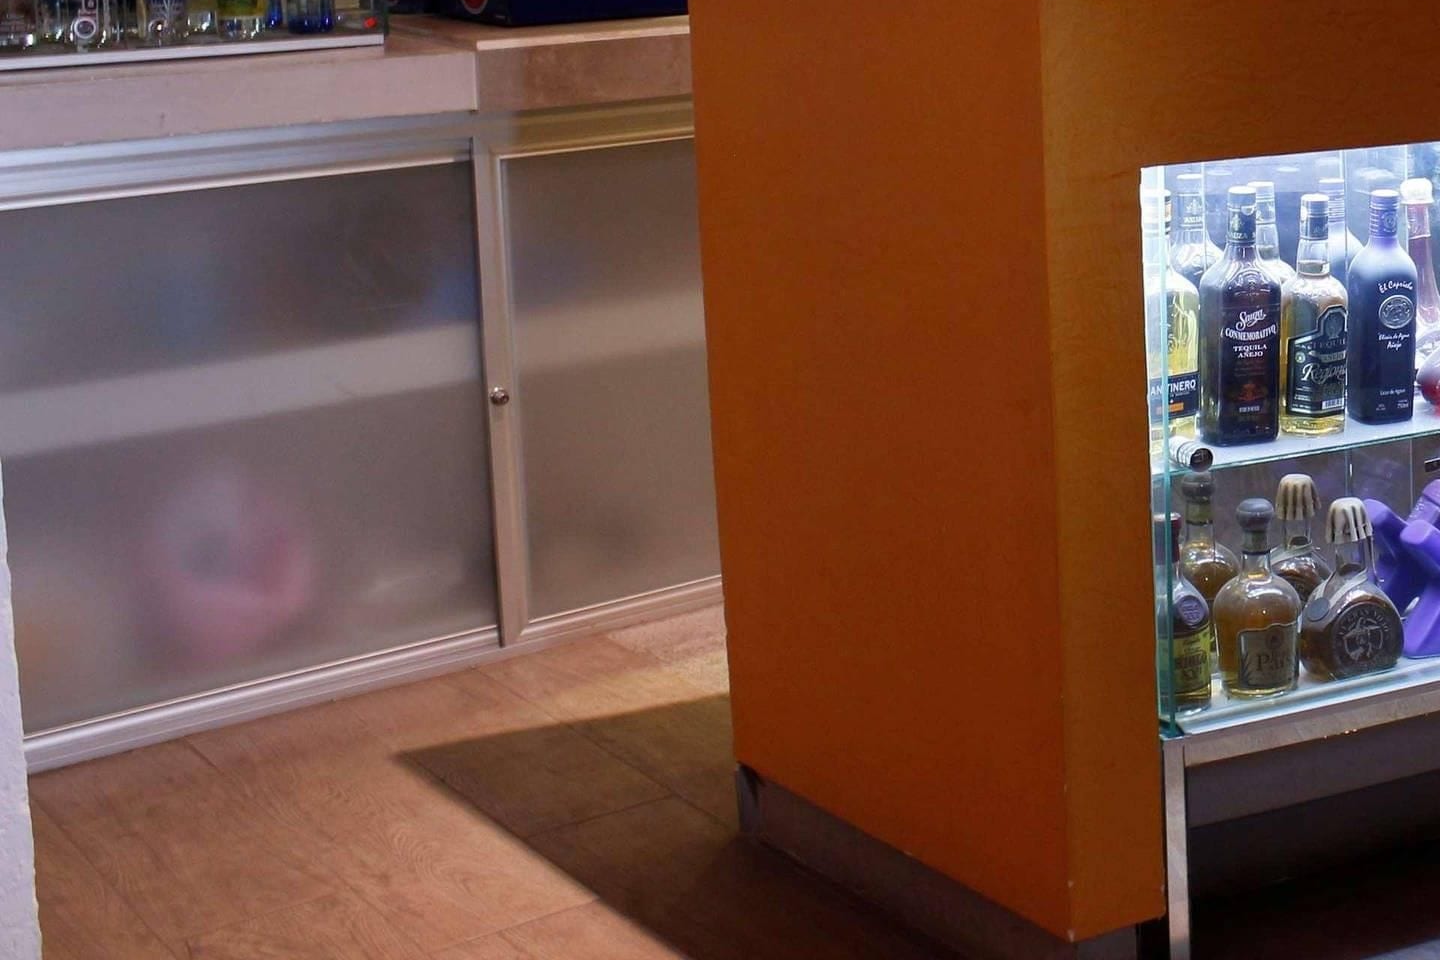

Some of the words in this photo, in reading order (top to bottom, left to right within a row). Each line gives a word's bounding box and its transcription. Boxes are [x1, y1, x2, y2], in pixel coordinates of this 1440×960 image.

[1235, 308, 1267, 331] Sauza
[1225, 324, 1277, 342] CONMEMORATIVO
[1232, 344, 1268, 352] TEQUILA
[1237, 351, 1264, 359] AÑEJO
